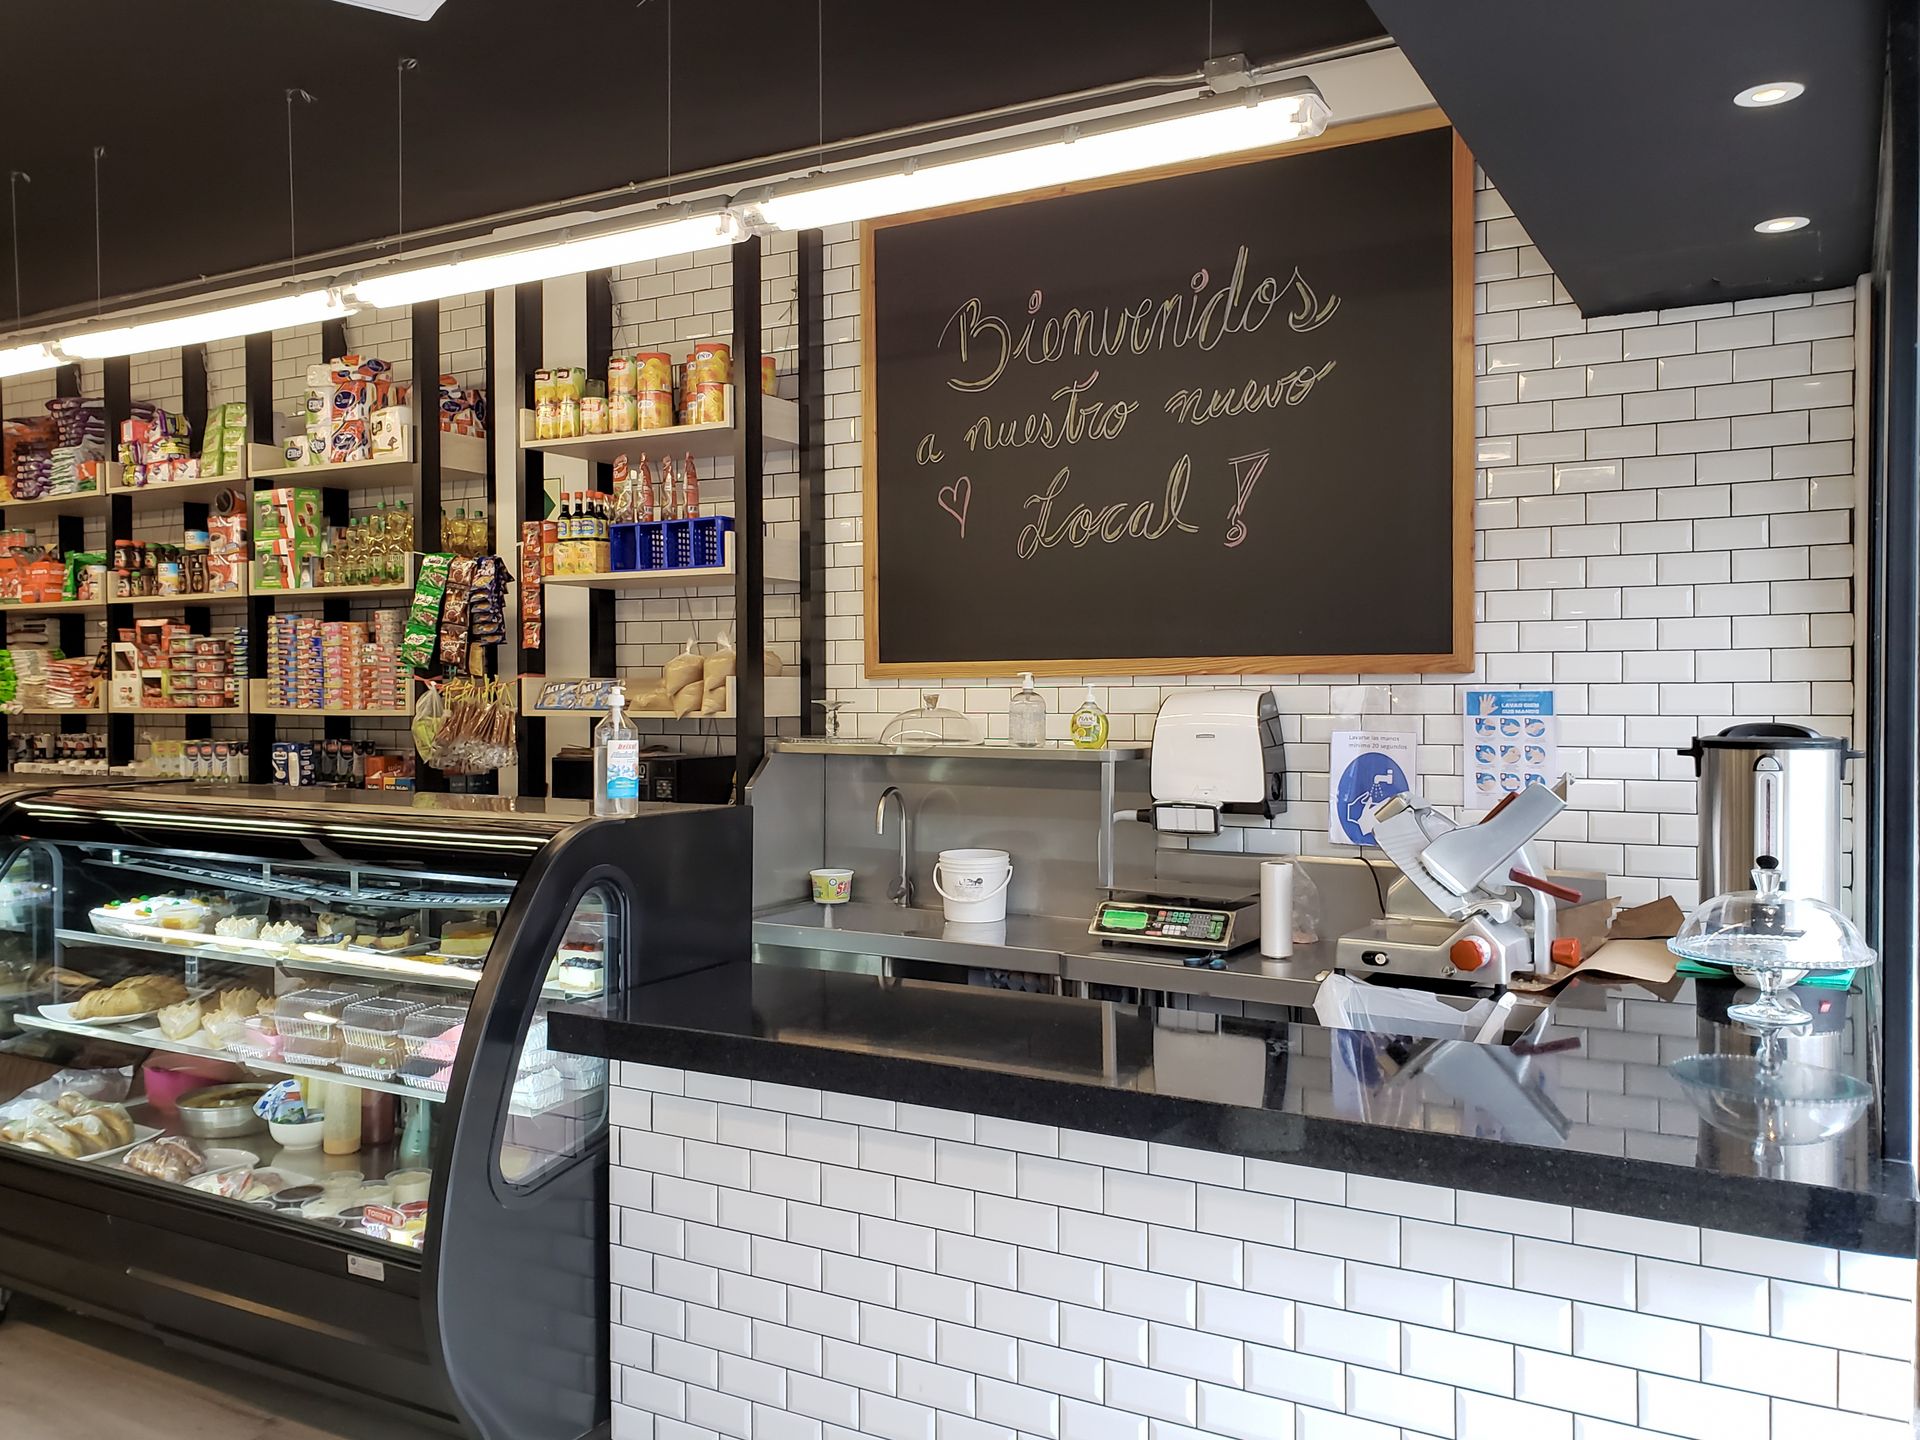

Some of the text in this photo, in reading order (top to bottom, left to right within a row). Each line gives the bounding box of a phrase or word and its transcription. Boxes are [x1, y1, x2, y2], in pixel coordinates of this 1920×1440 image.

[937, 245, 1341, 393] Bienvenidos
[916, 360, 1337, 466] a nuestro nuevo
[1017, 454, 1200, 560] Local
